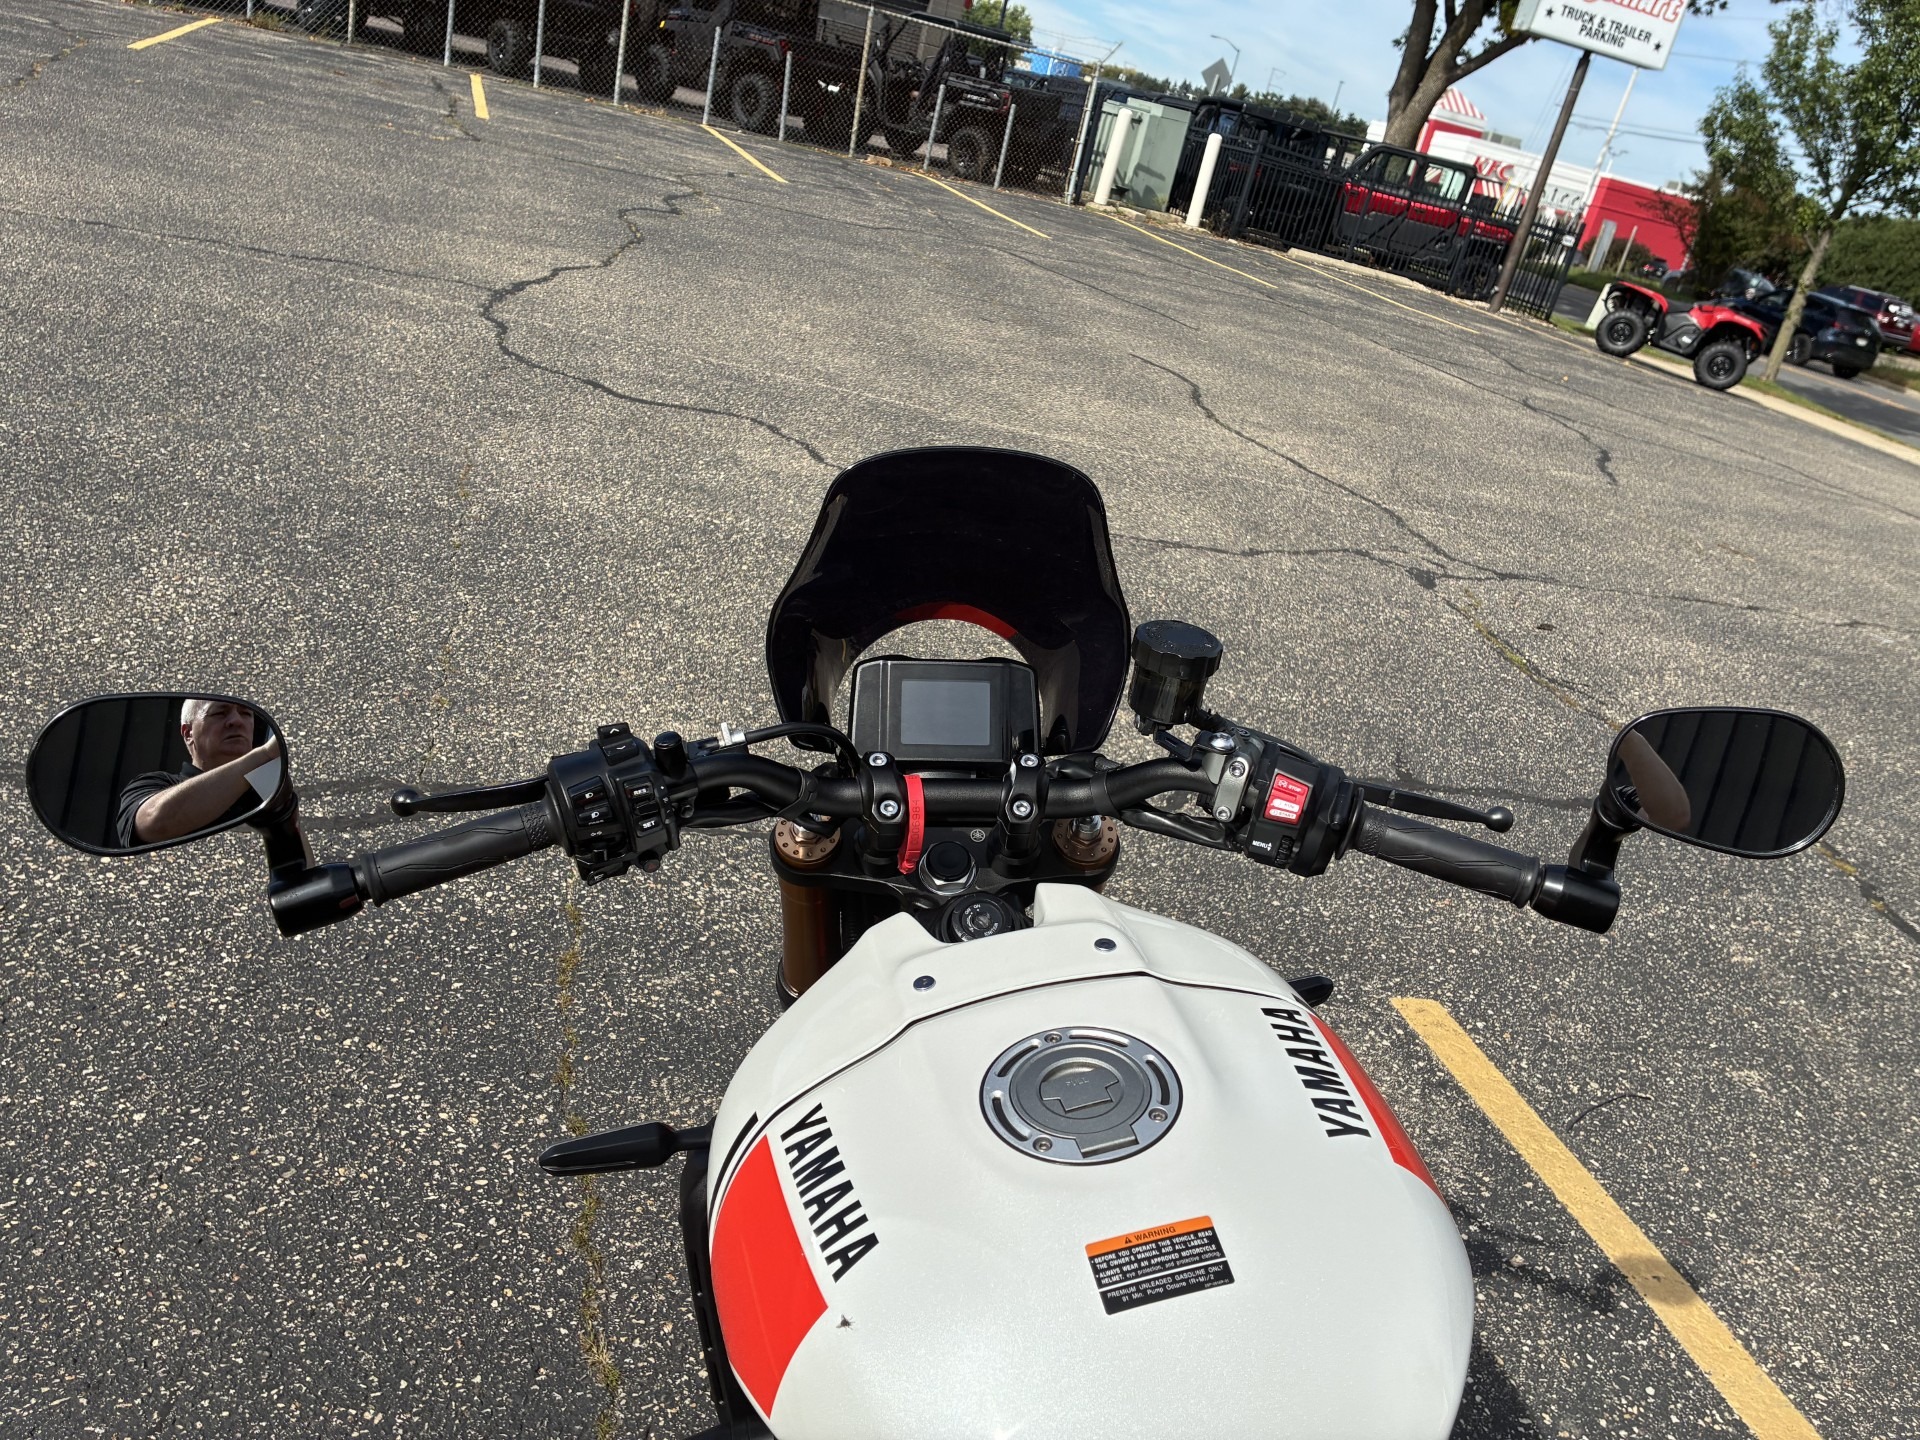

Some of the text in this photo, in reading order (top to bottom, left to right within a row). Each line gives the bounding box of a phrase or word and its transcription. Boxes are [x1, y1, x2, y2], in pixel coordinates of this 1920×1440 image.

[1561, 5, 1652, 43] TRUCK & TRAILER
[1579, 24, 1626, 48] PARKING
[1473, 155, 1515, 181] KFC
[1287, 784, 1302, 792] STOP
[642, 820, 655, 829] SET
[1252, 840, 1268, 849] MENU
[1260, 1008, 1372, 1138] YAMAHA
[780, 1102, 880, 1284] YAMAHA
[1094, 1253, 1116, 1263] BEFORE
[1117, 1249, 1130, 1257] YOU
[1131, 1243, 1156, 1254] OPERATE
[1157, 1239, 1170, 1247] THIS
[1197, 1229, 1212, 1238] READ
[1133, 1226, 1176, 1242] WARNING
[1096, 1262, 1108, 1270] THE
[1108, 1256, 1135, 1266] OWNER'S
[1136, 1249, 1159, 1260] MANUAL
[1160, 1245, 1173, 1253] AND
[1174, 1242, 1185, 1250] ALL
[1098, 1268, 1120, 1278] ALWAYS
[1122, 1262, 1138, 1272] WEAR
[1150, 1253, 1180, 1264] APPROVED
[1180, 1244, 1216, 1258] MOTORCYCLE
[1164, 1260, 1174, 1268] and
[1106, 1263, 1224, 1298] PREMIUM UNLEADED GASOLINE ONLY
[1131, 1290, 1144, 1300] Min.
[1146, 1286, 1164, 1296] Pump
[1165, 1280, 1187, 1291] Octane
[1188, 1273, 1214, 1285] (R+M)/2
